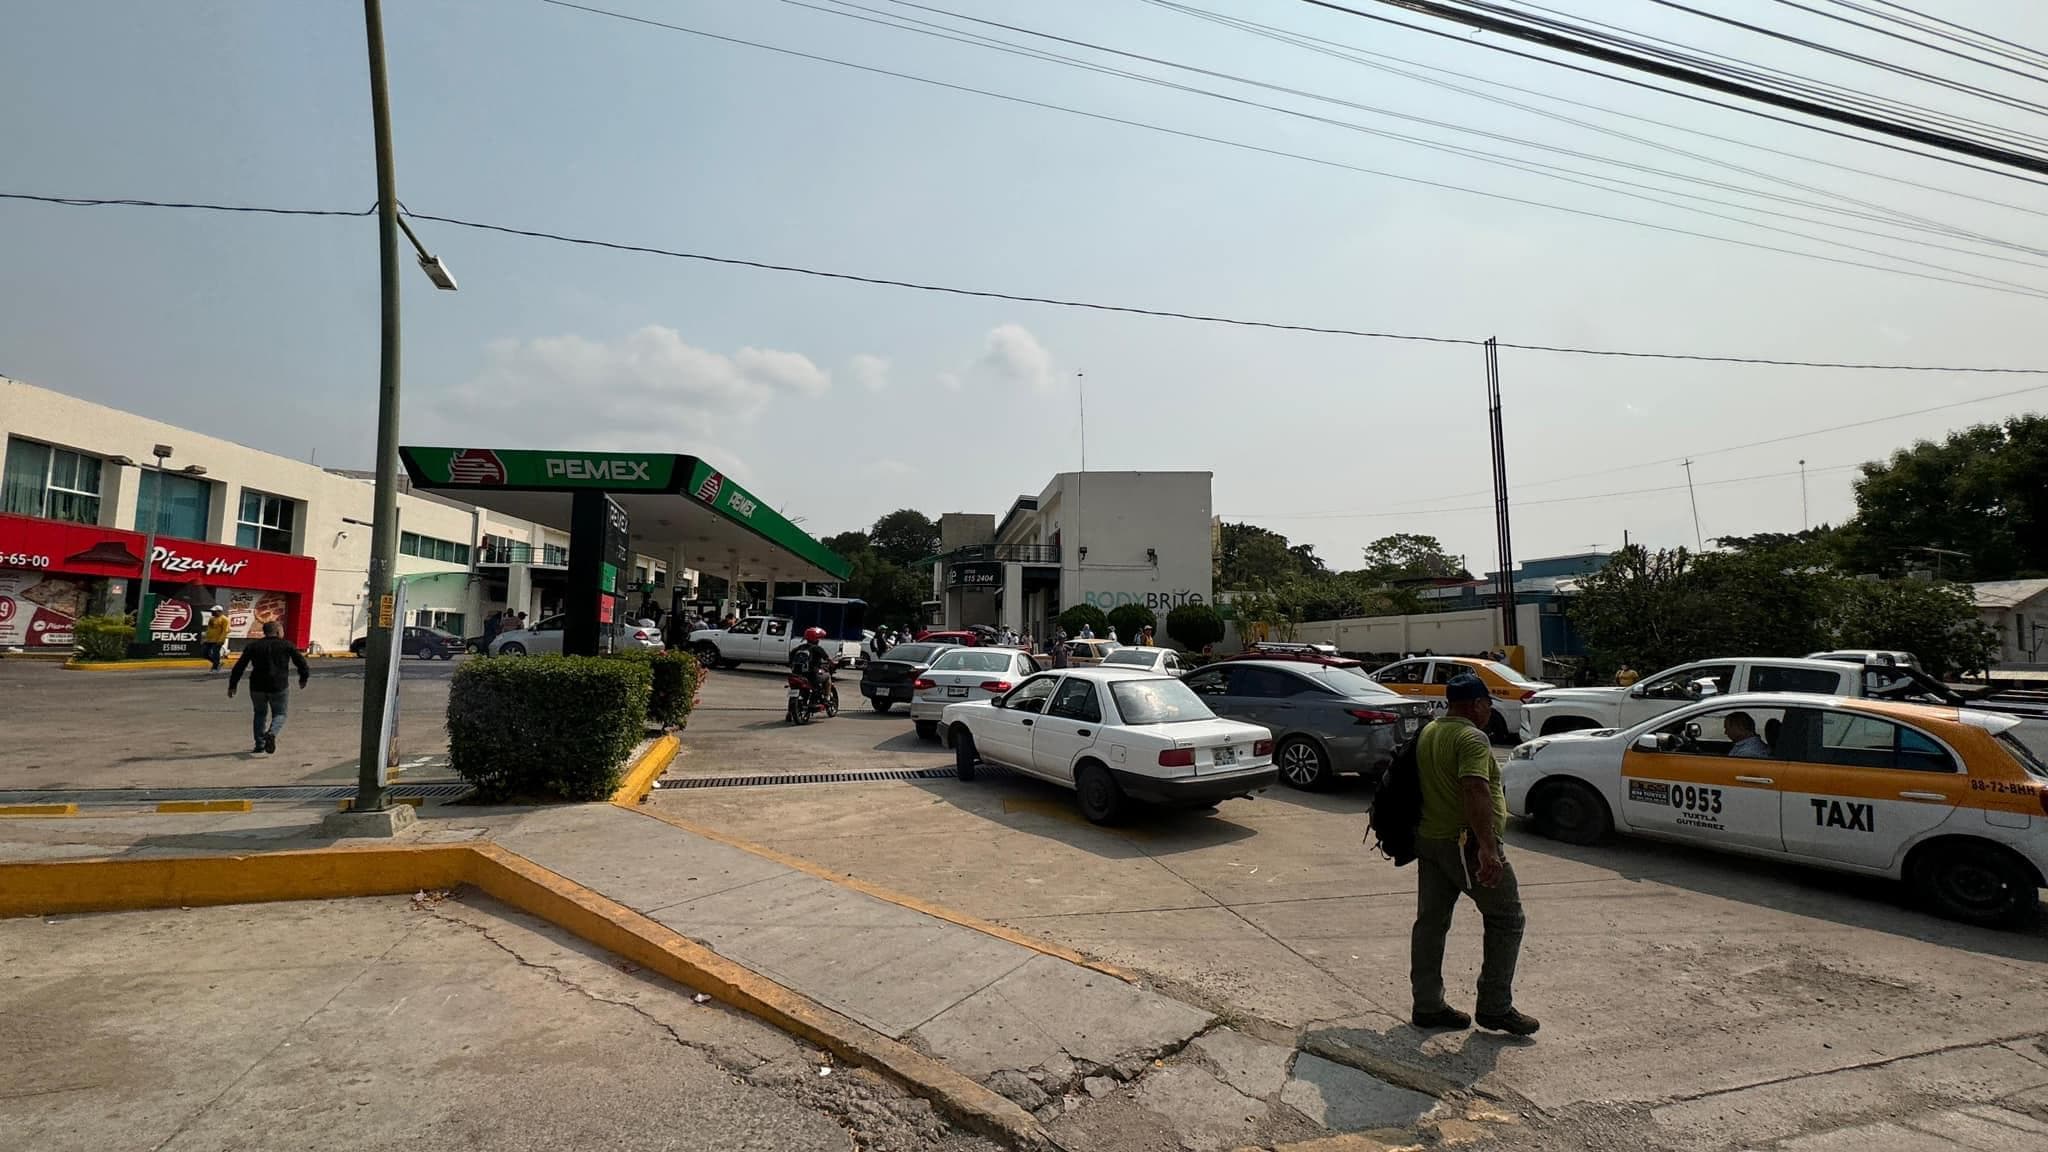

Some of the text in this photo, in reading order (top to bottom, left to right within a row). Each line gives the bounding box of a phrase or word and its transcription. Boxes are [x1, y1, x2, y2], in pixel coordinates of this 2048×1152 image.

[546, 458, 650, 481] PEMEX
[726, 491, 758, 519] PEMEX
[609, 504, 629, 535] PEMEX
[151, 545, 248, 576] Pizza Hut
[151, 631, 198, 642] PEMEX
[1429, 700, 1449, 710] TAX
[1671, 784, 1722, 815] 0953
[1682, 811, 1718, 823] TUXTLA
[1810, 797, 1874, 833] TAXI
